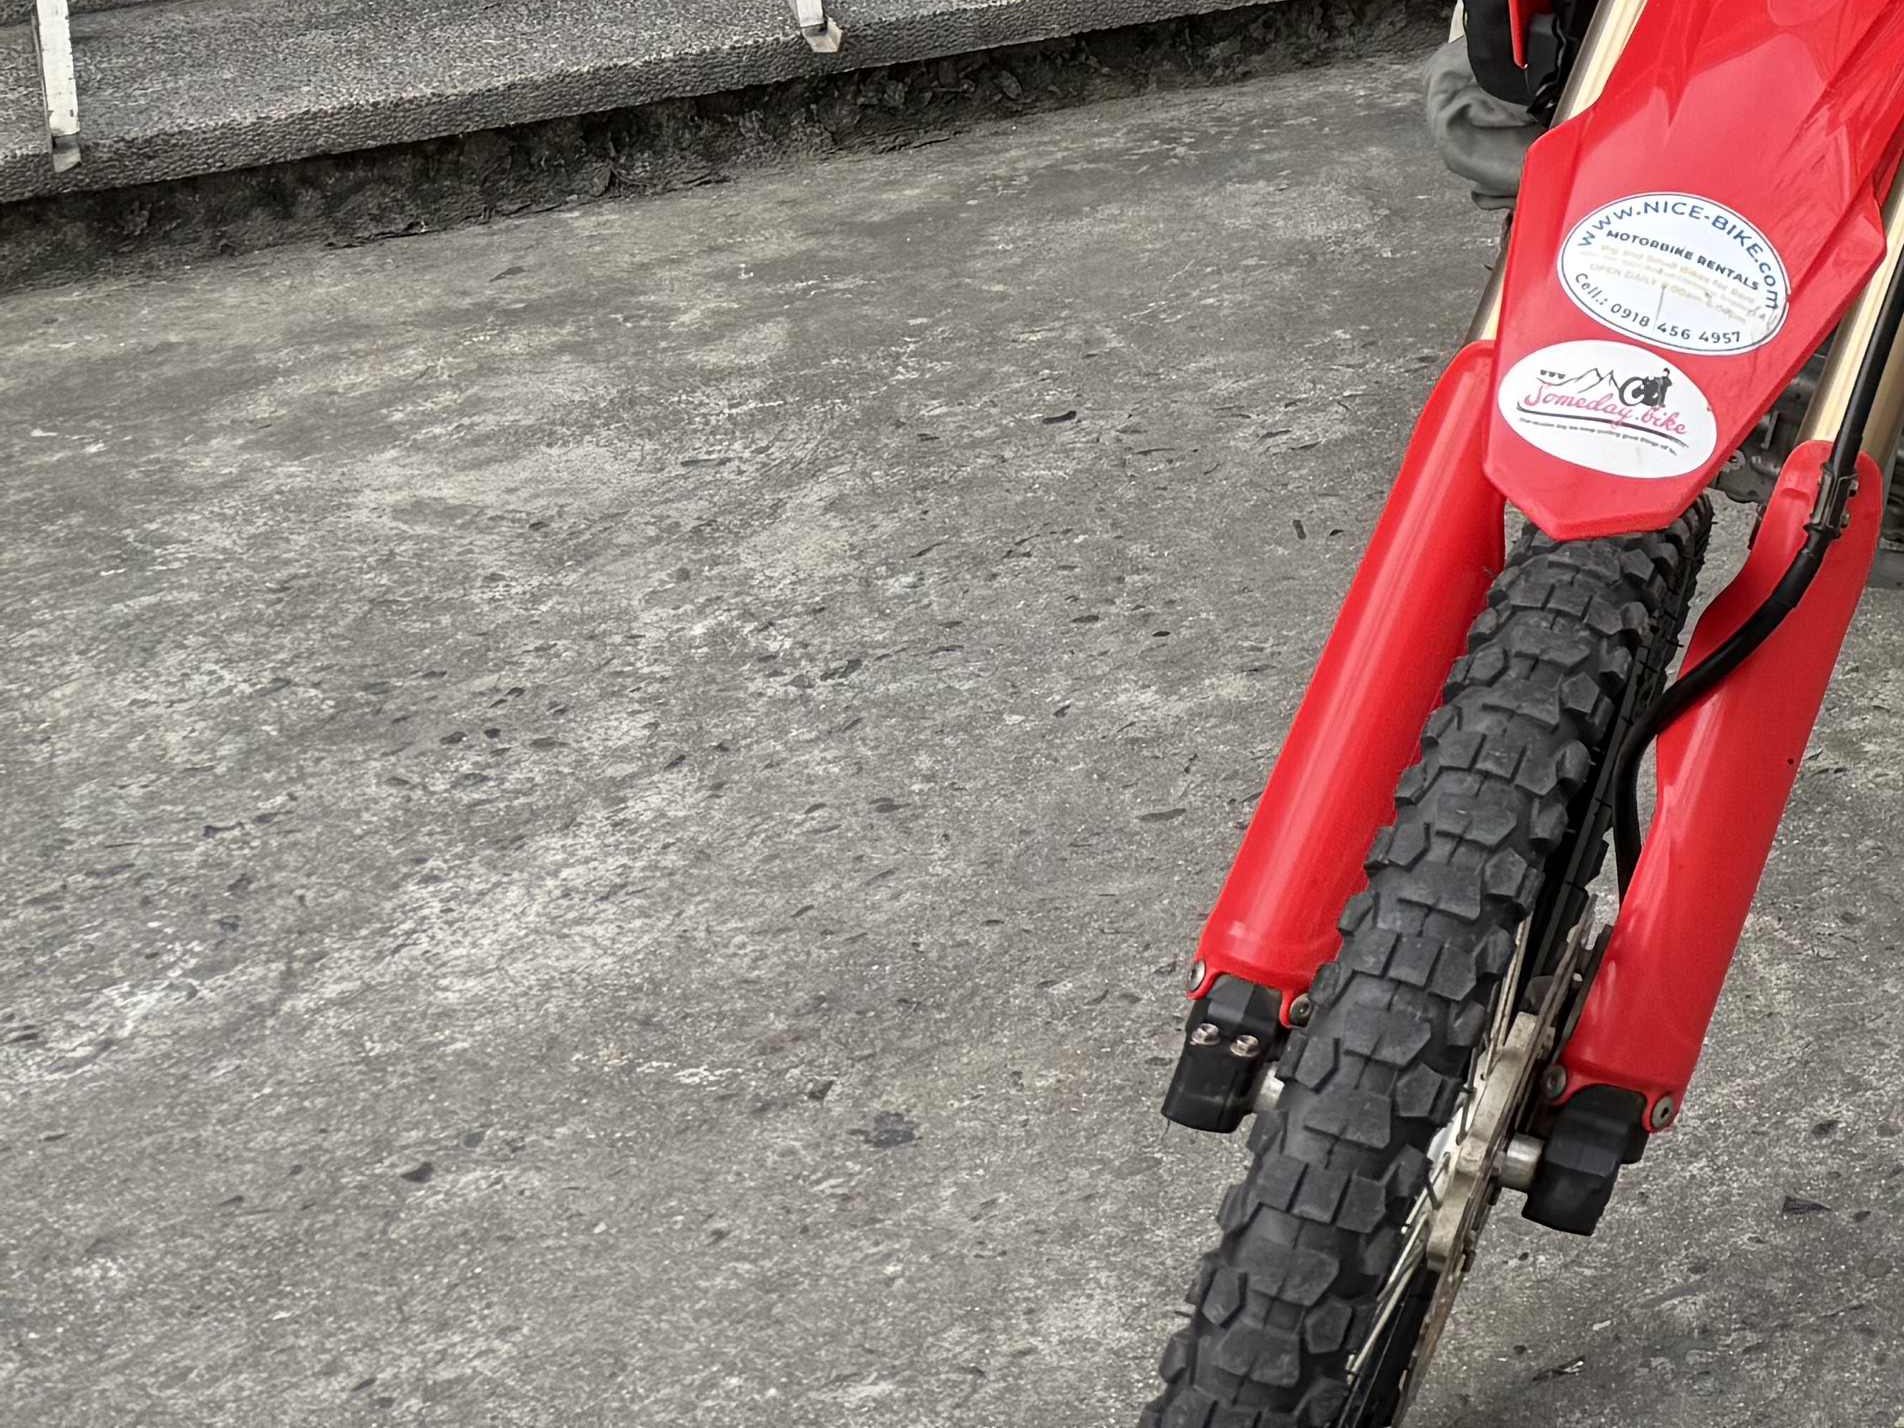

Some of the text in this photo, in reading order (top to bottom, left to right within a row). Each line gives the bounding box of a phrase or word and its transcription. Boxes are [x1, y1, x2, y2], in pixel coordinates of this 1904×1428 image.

[1606, 229, 1760, 292] MOTORBIKE RENTALS
[1610, 302, 1651, 328] 0918
[1656, 322, 1692, 340] 456
[1698, 330, 1742, 344] 4957
